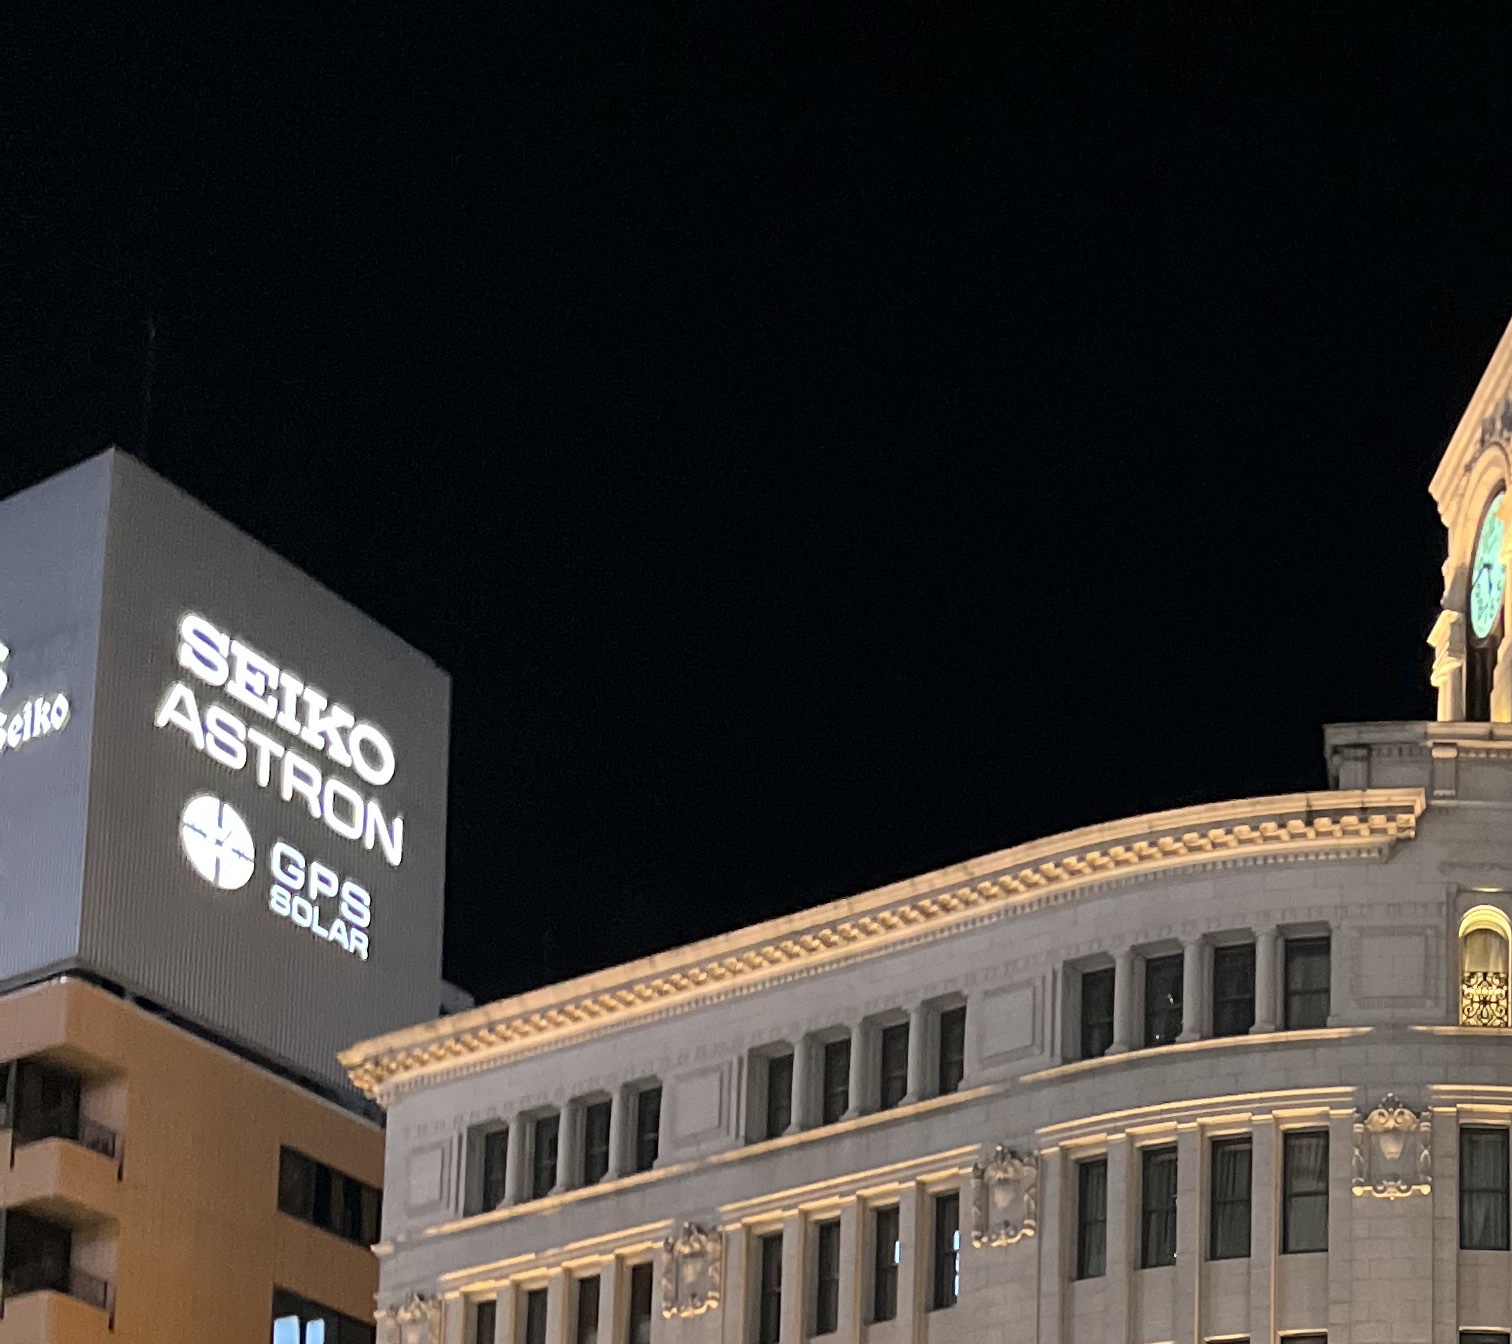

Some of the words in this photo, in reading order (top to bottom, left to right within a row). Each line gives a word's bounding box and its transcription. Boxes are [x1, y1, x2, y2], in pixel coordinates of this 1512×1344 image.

[179, 612, 395, 786] SEIKO
[155, 681, 404, 867] ASTRON
[270, 842, 371, 928] GPS
[270, 885, 370, 961] SOLAR
